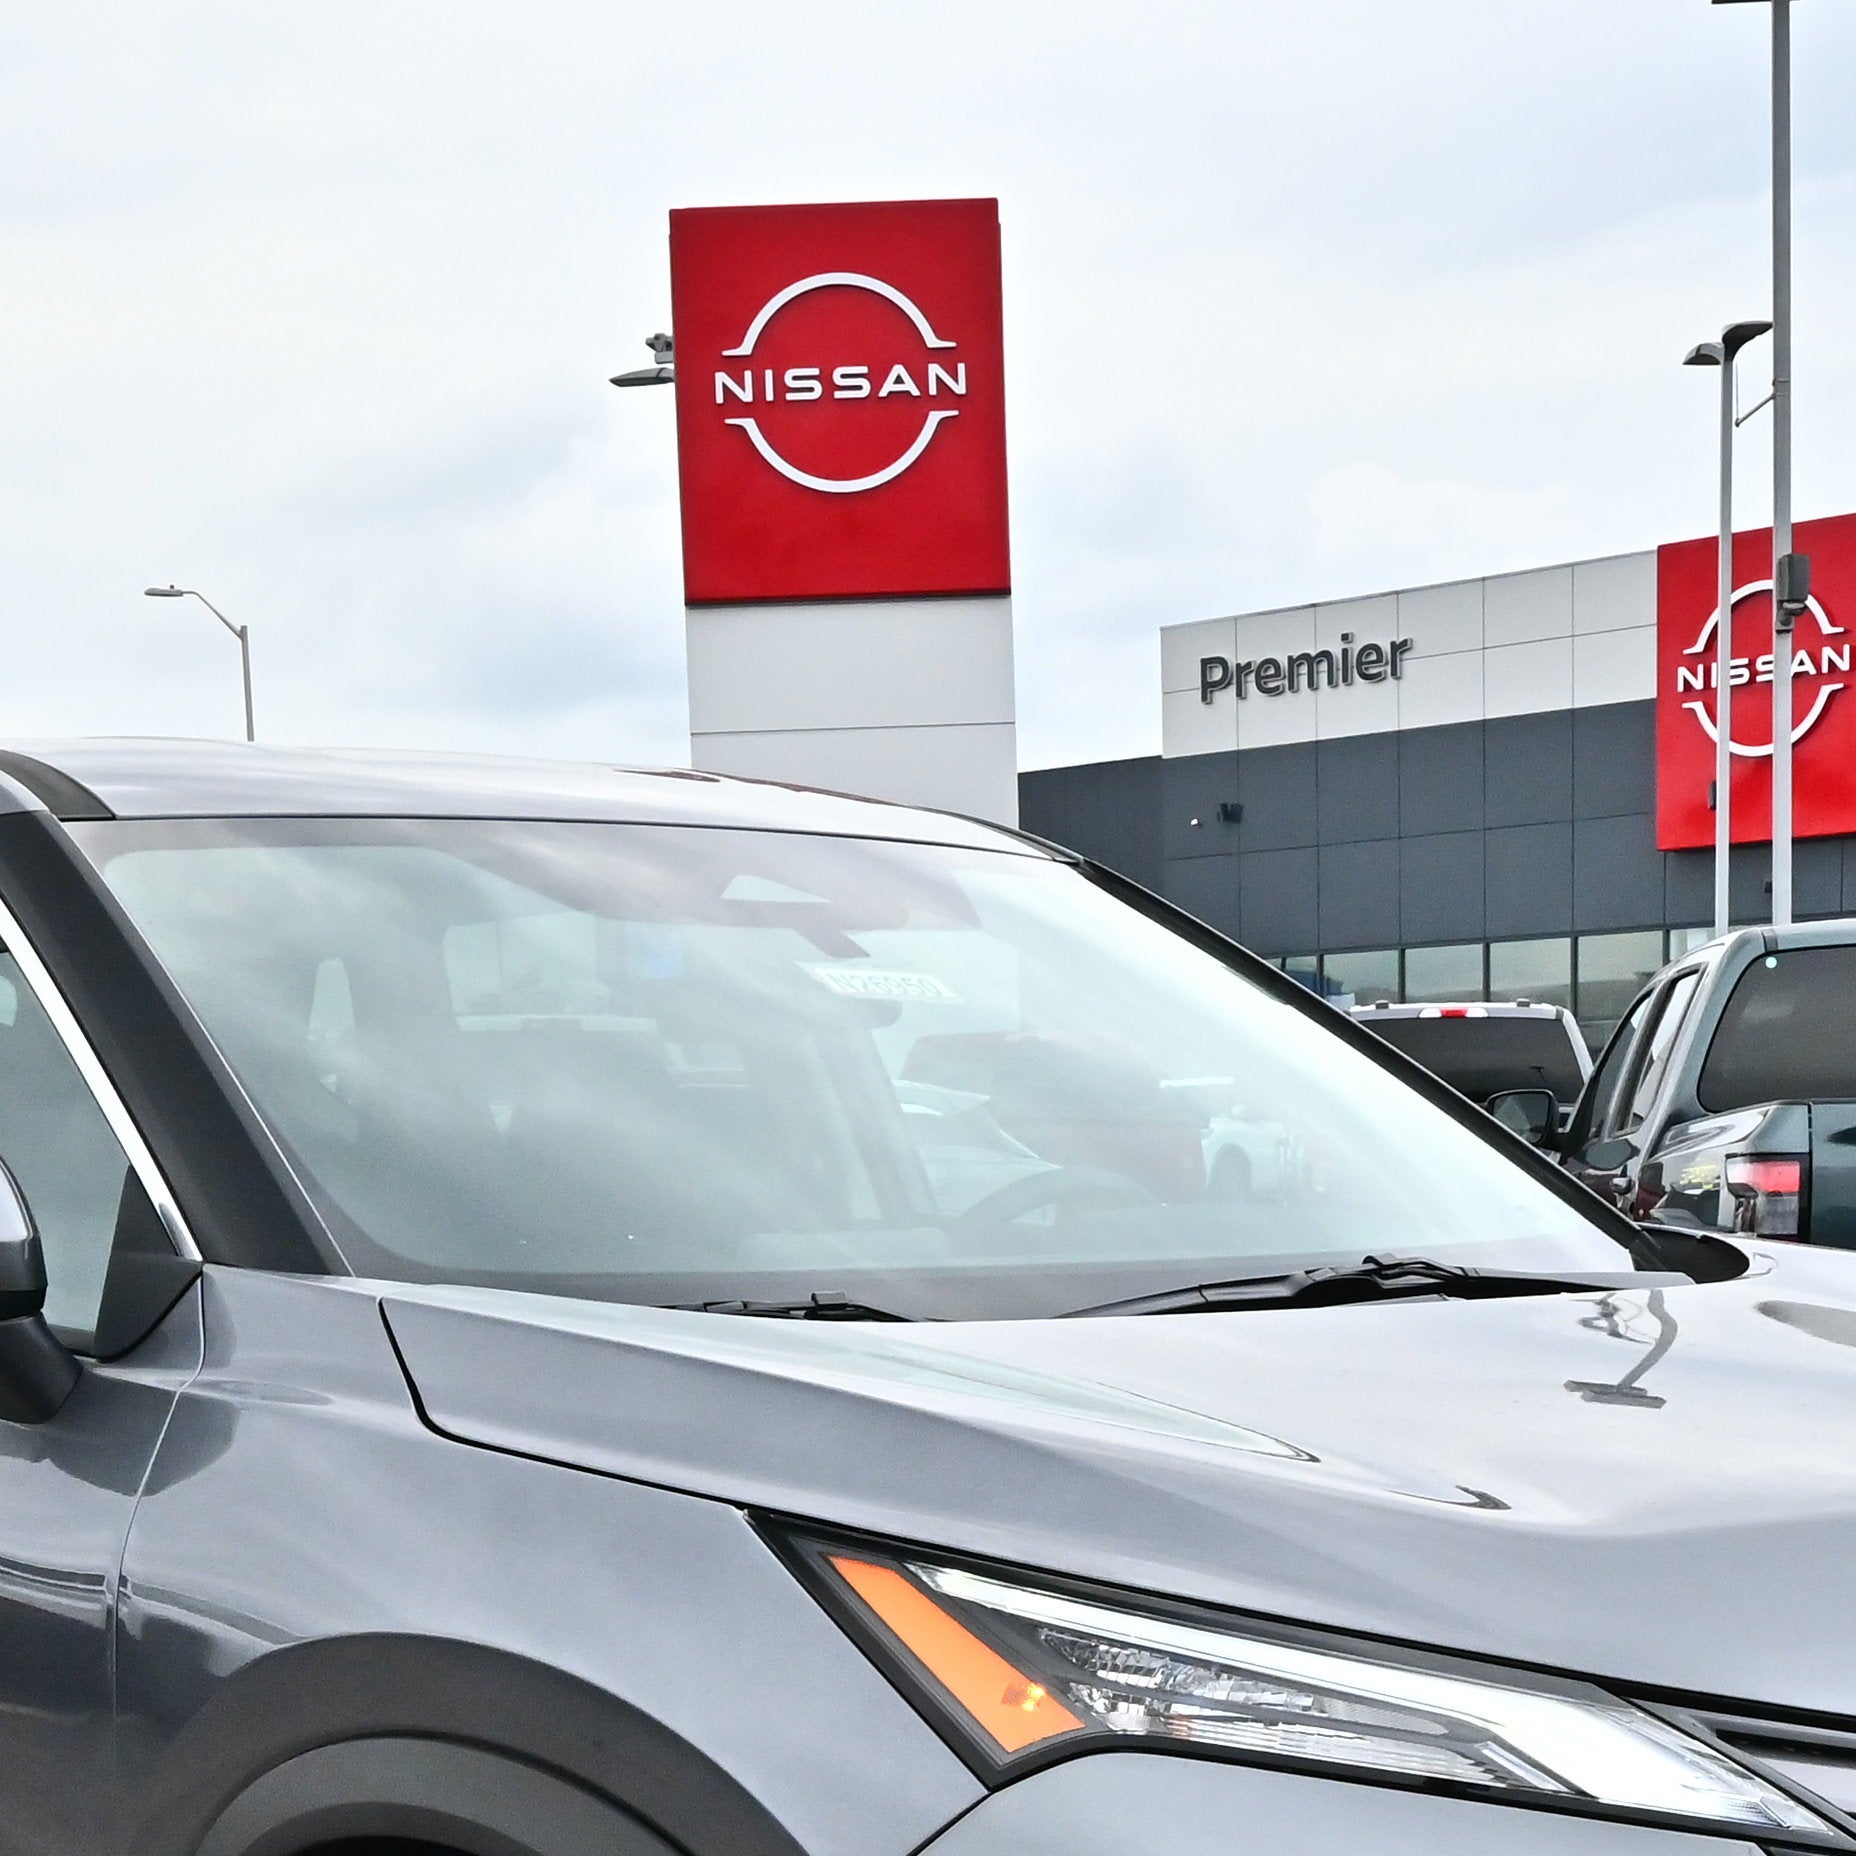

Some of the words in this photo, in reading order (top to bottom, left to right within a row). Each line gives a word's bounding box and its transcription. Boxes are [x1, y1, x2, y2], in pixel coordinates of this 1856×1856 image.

[714, 362, 968, 405] NISSAN
[1200, 632, 1413, 705] Premier
[1676, 643, 1852, 693] NISSAN
